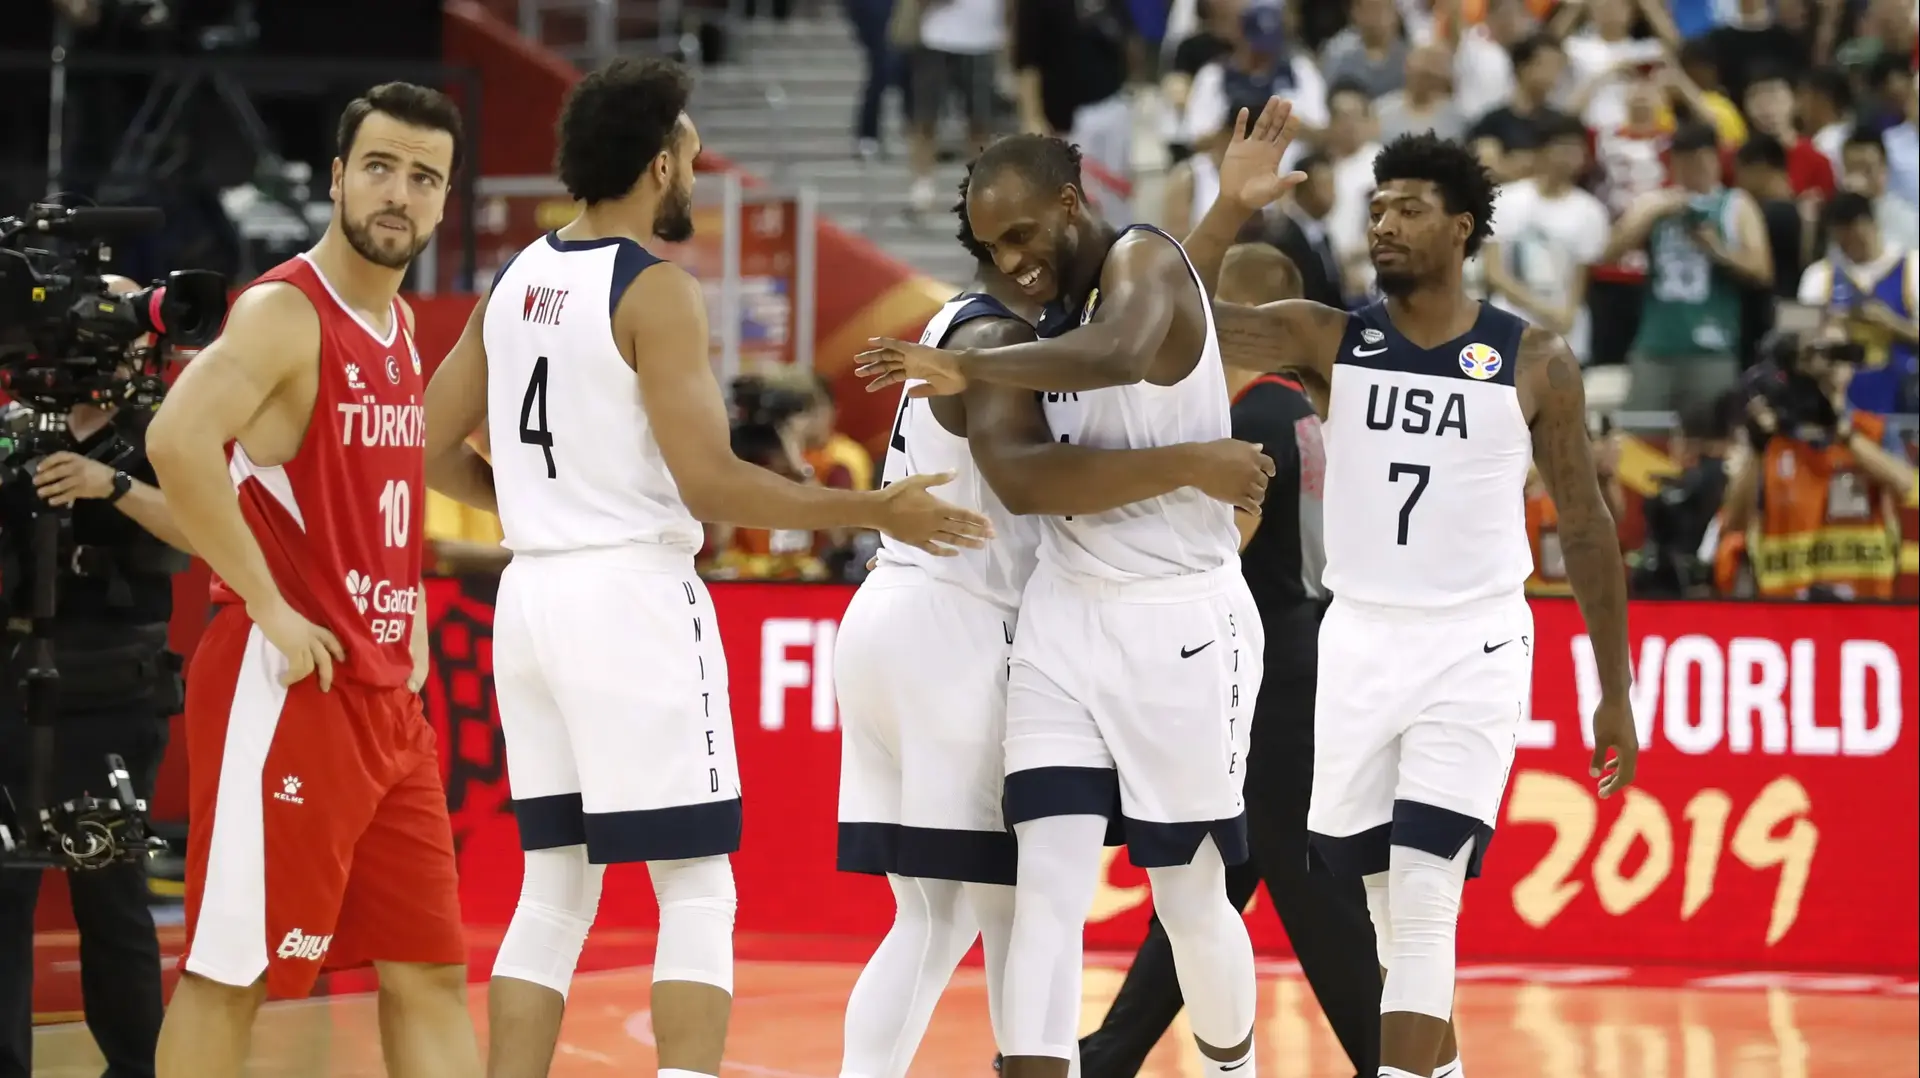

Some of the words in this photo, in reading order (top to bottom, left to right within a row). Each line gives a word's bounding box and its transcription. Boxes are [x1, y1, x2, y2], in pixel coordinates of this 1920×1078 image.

[523, 285, 569, 325] WHITE
[519, 356, 556, 479] 4
[1366, 384, 1468, 440] USA
[379, 480, 410, 548] 10
[1388, 462, 1431, 546] 7
[682, 580, 719, 793] UNITED
[1570, 633, 1903, 757] WORLD
[273, 791, 305, 805] KELME
[1507, 768, 1820, 948] 2019
